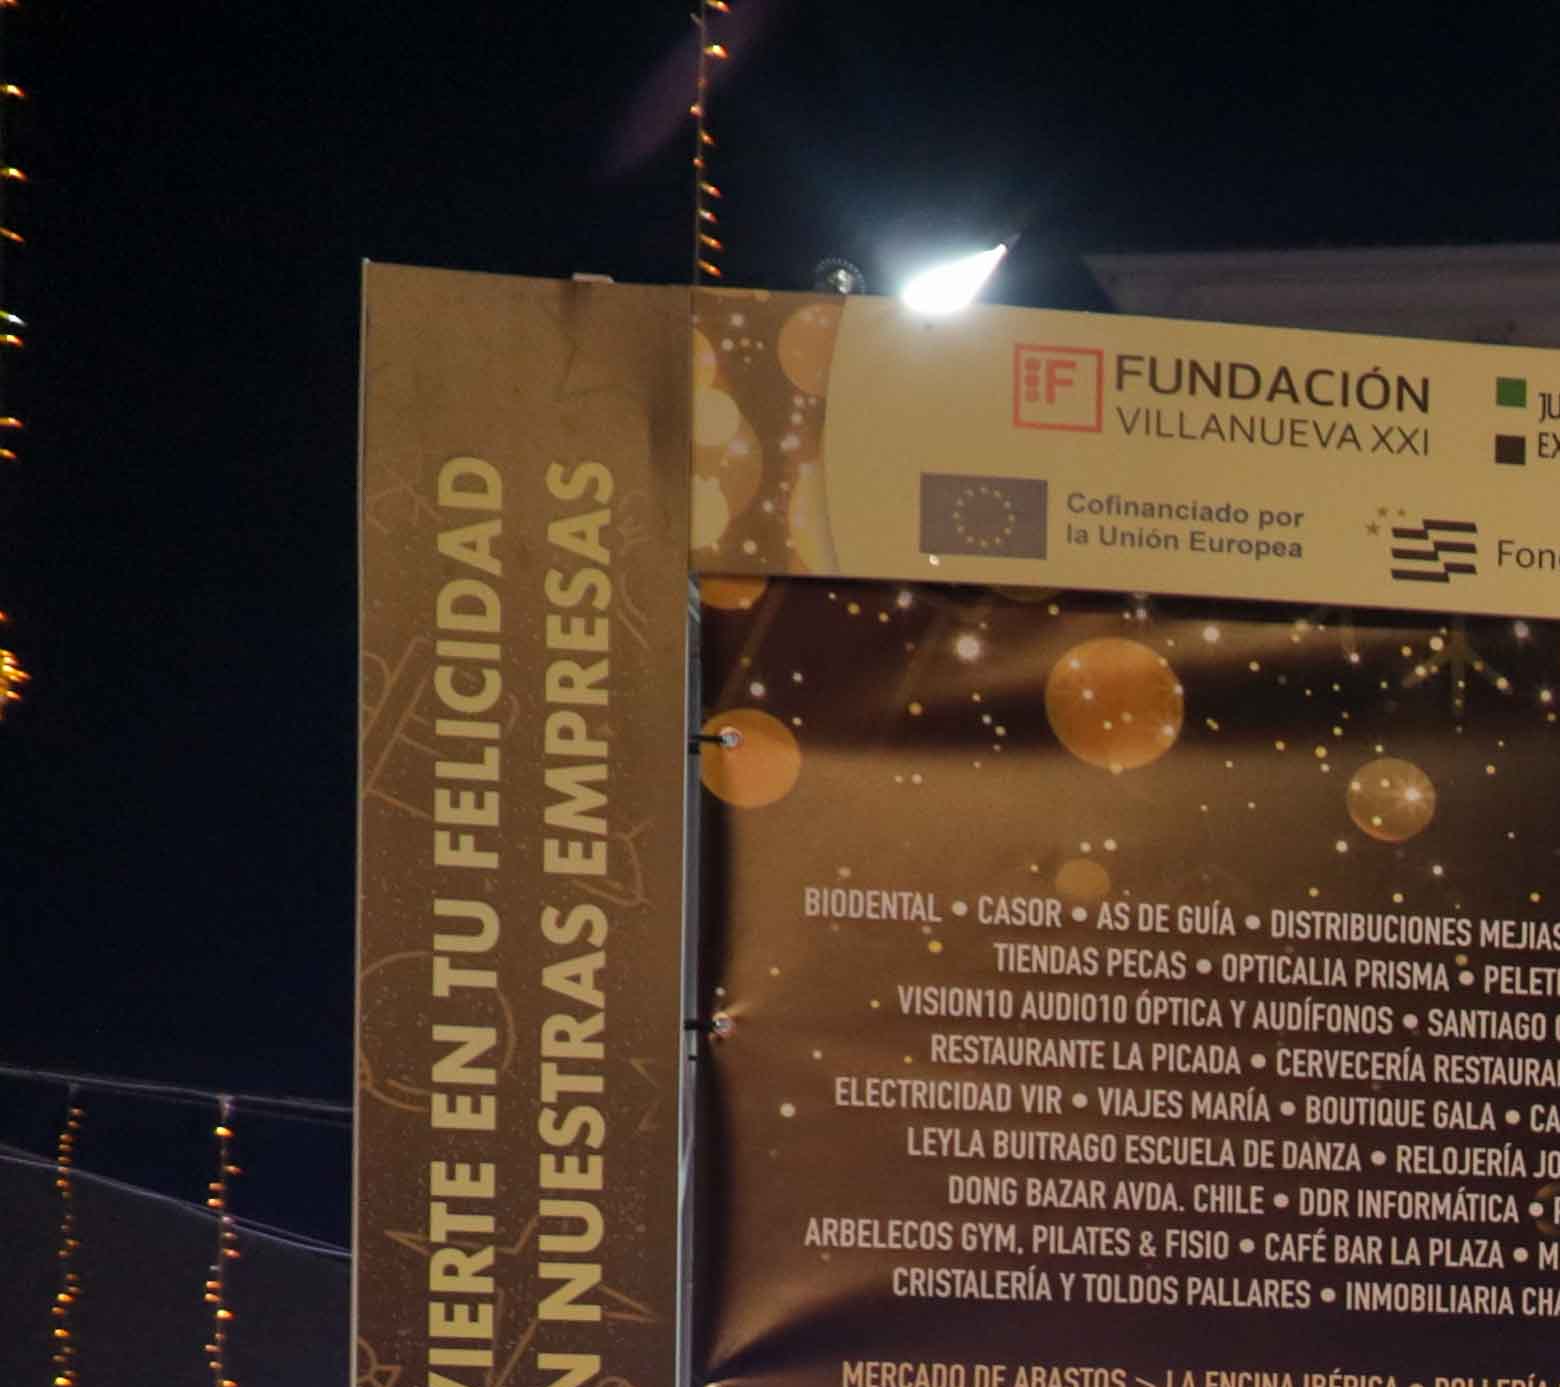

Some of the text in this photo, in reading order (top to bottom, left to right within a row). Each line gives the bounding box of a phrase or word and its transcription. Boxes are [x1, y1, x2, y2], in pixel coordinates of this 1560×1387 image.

[1115, 354, 1431, 414] FUNDACIÓN
[1116, 405, 1430, 457] VILLANUEVA XXI
[1066, 491, 1305, 533] Cofinanciado por
[1066, 524, 1304, 563] la Unión Europea
[434, 454, 504, 869] FELICIDAD
[542, 460, 615, 877] EMPRESAS
[805, 888, 1236, 936] BIODENTAL CASOR AS DE GUÍA
[434, 897, 501, 1001] TU
[993, 942, 1186, 980] TIENDAS PECAS
[898, 985, 1127, 1024] VISION10 AUDIO10
[432, 1025, 498, 1132] EN
[836, 1077, 1062, 1114] ELECTRICIDAD VIR
[538, 900, 608, 1328] NUESTRAS
[805, 1217, 953, 1250] ARBELECOS
[1033, 1225, 1130, 1256] PILATES
[1139, 1231, 1156, 1257] &
[1166, 1229, 1229, 1259] FISIO
